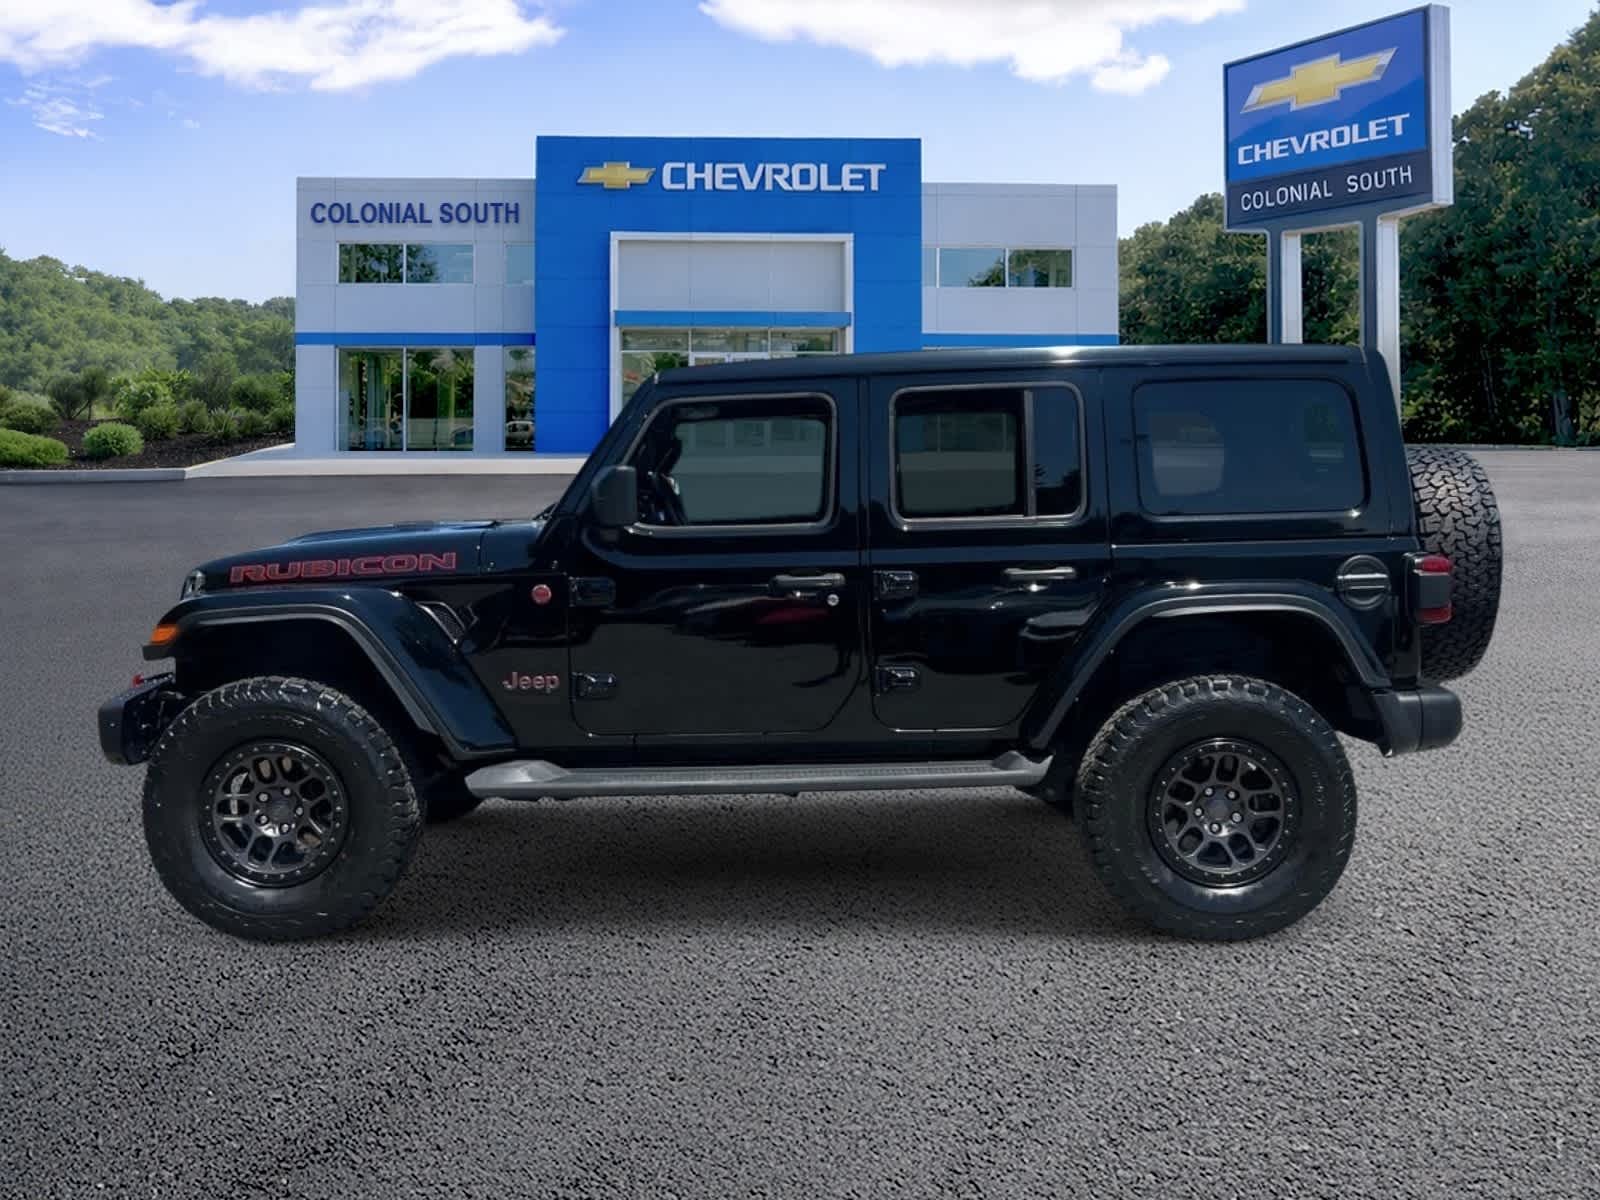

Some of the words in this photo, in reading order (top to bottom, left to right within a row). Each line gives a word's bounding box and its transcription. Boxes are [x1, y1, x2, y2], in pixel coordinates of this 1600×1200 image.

[1238, 113, 1410, 165] CHEVROLET
[662, 162, 887, 192] CHEVROLET
[1241, 180, 1333, 211] COLONIAL
[1347, 166, 1412, 194] SOUTH
[310, 202, 433, 224] COLONIAL
[439, 202, 520, 224] SOUTH
[230, 552, 457, 583] RUBICON
[503, 671, 560, 695] Jeep
